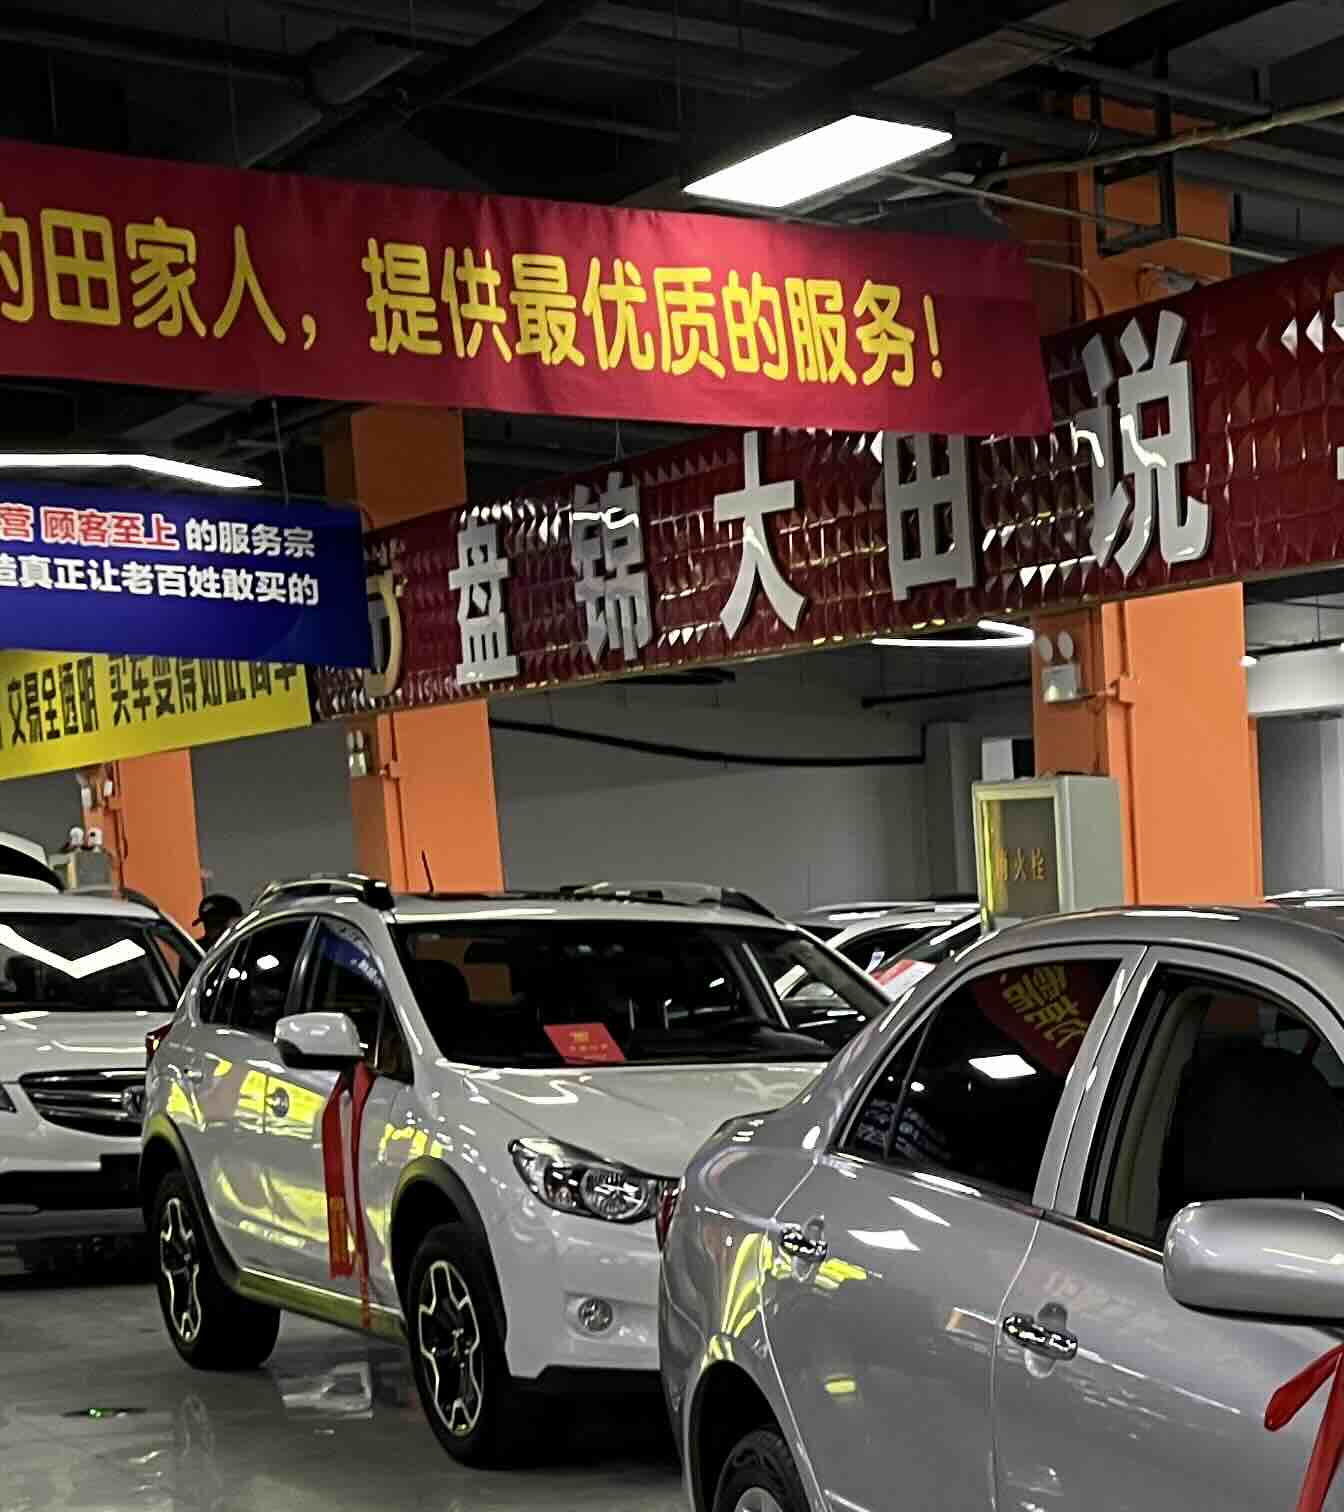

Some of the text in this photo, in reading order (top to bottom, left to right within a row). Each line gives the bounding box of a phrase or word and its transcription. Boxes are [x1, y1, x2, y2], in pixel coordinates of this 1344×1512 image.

[40, 506, 180, 550] 顾客至上
[185, 517, 315, 558] 的服务宗
